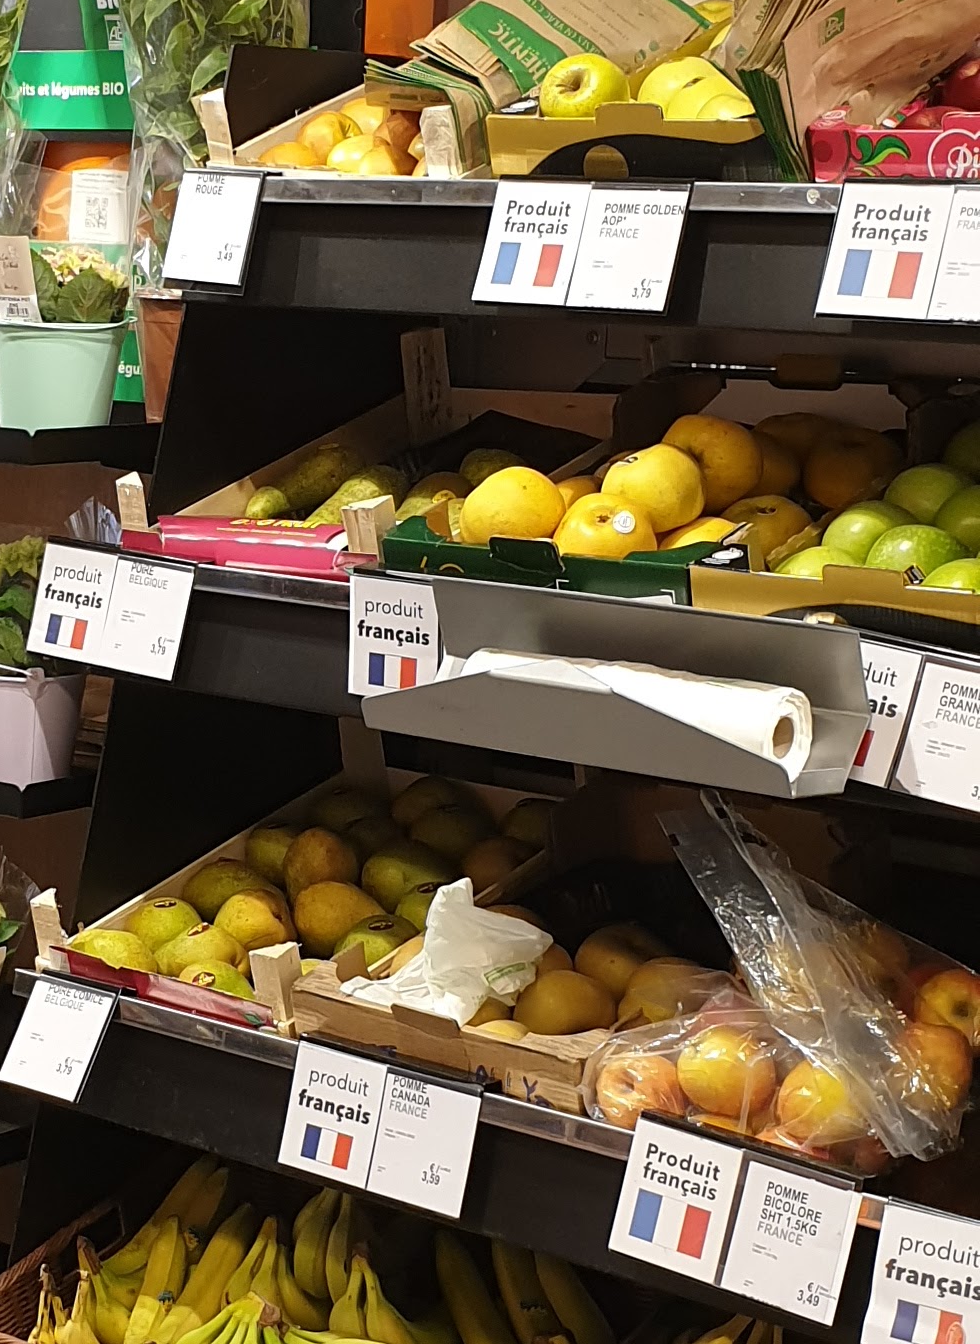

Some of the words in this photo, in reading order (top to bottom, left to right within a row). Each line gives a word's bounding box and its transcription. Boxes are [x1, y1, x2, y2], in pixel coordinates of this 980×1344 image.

[487, 21, 552, 86] HENTIC
[20, 82, 35, 96] its
[38, 84, 49, 96] et
[51, 81, 100, 100] légumes
[102, 82, 124, 96] BIO
[195, 184, 223, 196] ROUGE
[506, 200, 571, 217] Produit
[604, 203, 641, 215] POMME
[643, 205, 685, 216] GOLDEN
[854, 203, 931, 223] Produit
[504, 217, 568, 238] français
[599, 228, 640, 239] FRANCE
[852, 221, 929, 246] français
[217, 251, 233, 262] 3,49
[632, 287, 652, 299] 3,79
[118, 360, 140, 378] égu
[53, 565, 103, 585] produit
[128, 574, 169, 590] BELGIQUE
[44, 583, 103, 609] français
[365, 599, 424, 620] produit
[357, 619, 431, 646] français
[863, 661, 898, 687] duit
[868, 695, 898, 718] ais
[45, 993, 85, 1011] BELGIQUE
[309, 1069, 369, 1097] produit
[393, 1076, 428, 1094] POMME
[298, 1088, 371, 1125] français
[391, 1088, 430, 1108] CANADA
[389, 1101, 428, 1119] FRANCE
[646, 1142, 721, 1182] Produit
[421, 1170, 440, 1186] 3,59
[642, 1161, 718, 1201] français
[767, 1181, 809, 1205] POMME
[763, 1194, 823, 1224] BICOLORE
[760, 1208, 786, 1226] SHT
[786, 1215, 818, 1237] 1.5KG
[757, 1220, 804, 1247] FRANCE
[898, 1236, 980, 1269] produit
[885, 1258, 980, 1301] français
[796, 1289, 820, 1307] 3,49
